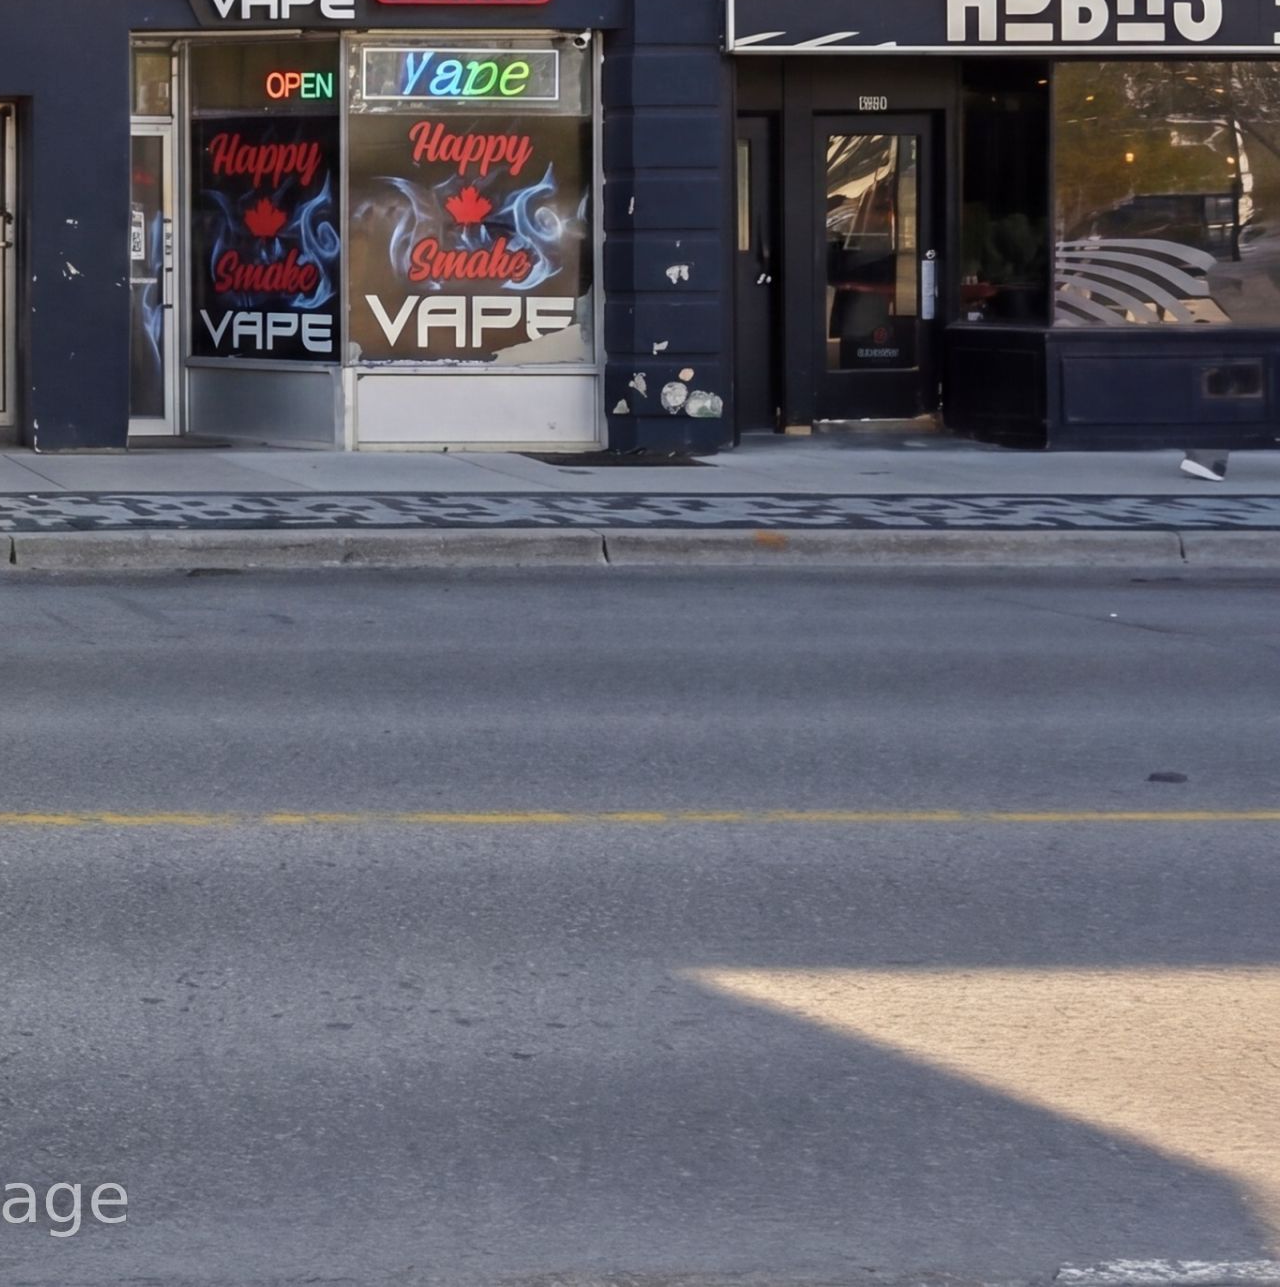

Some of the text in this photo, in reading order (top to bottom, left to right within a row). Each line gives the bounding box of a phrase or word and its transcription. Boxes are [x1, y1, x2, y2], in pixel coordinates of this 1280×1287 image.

[266, 72, 333, 98] OPEN
[209, 133, 322, 188] Happy
[408, 121, 533, 176] Happy
[199, 309, 333, 352] VAPE
[364, 294, 575, 349] VAPE
